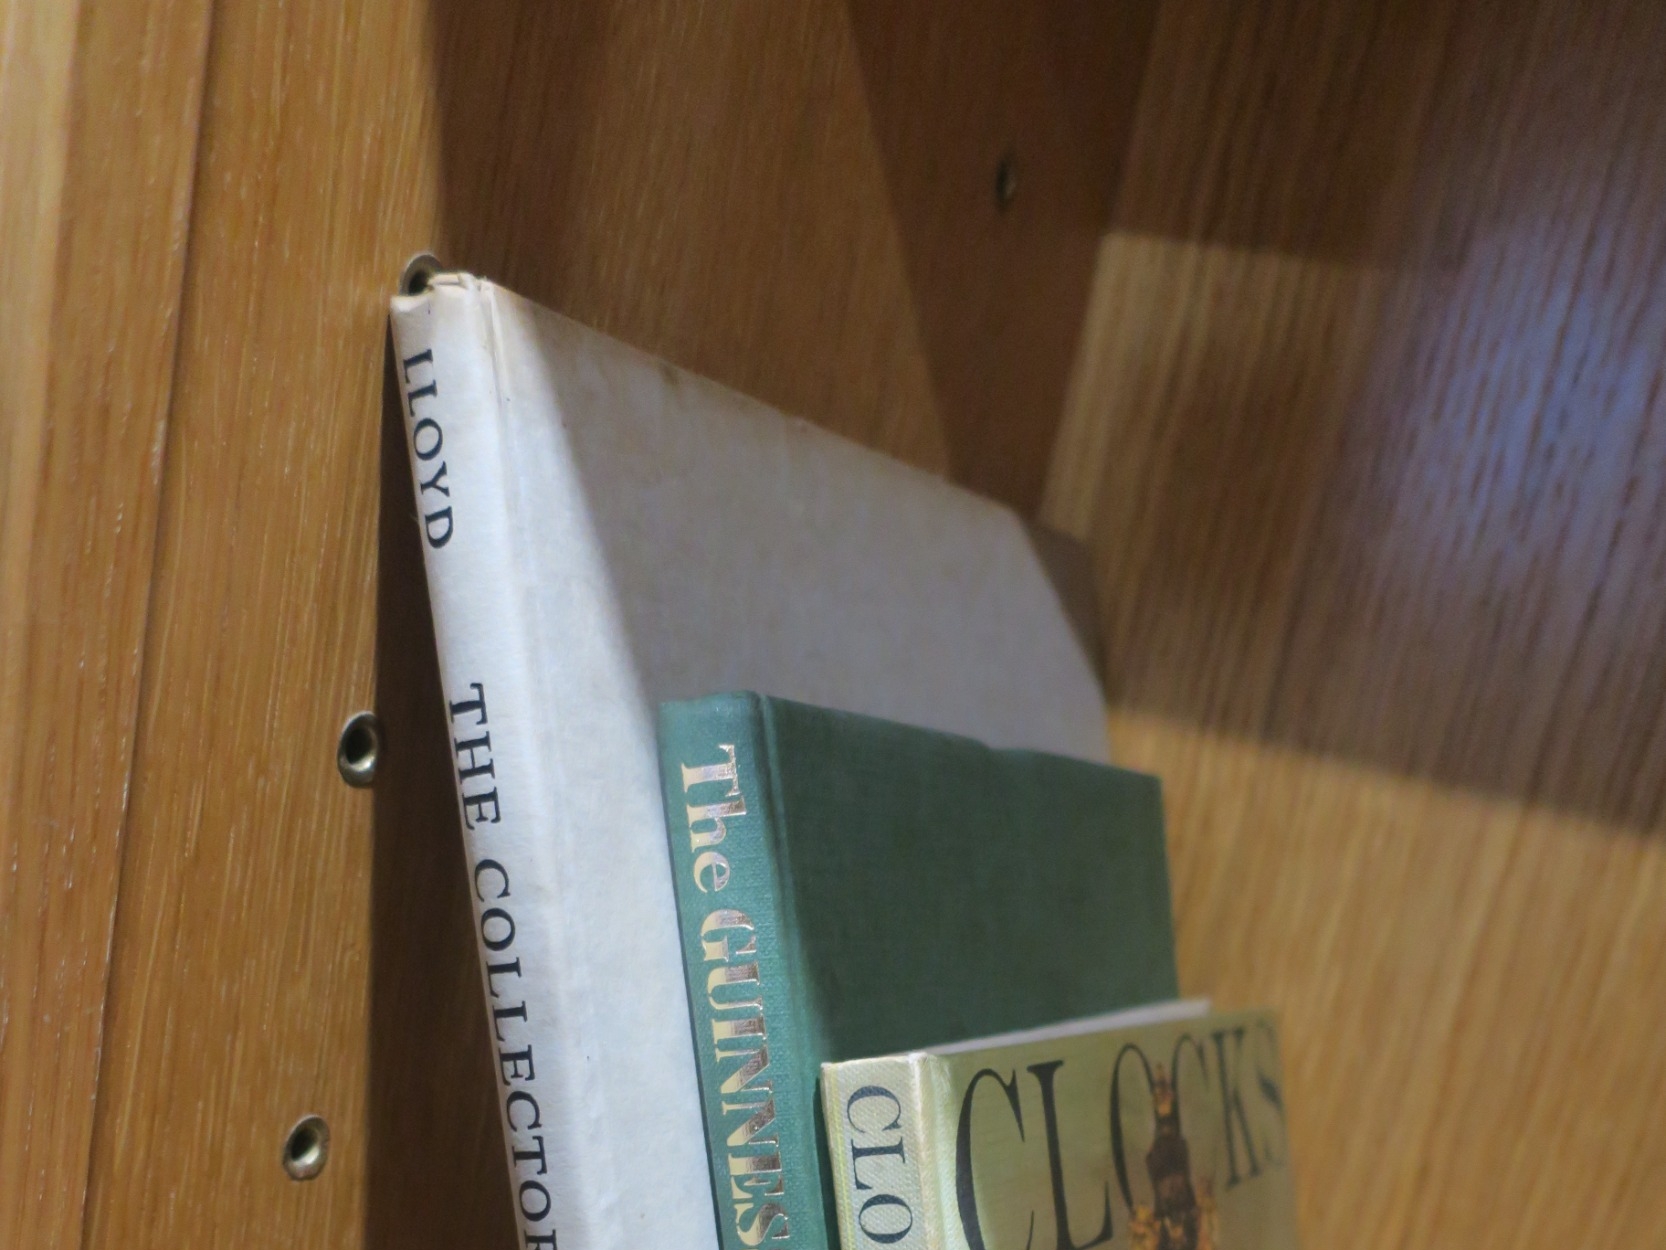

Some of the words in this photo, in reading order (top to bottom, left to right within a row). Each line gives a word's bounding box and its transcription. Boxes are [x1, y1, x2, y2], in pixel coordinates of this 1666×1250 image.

[403, 347, 454, 551] LLOYD
[445, 682, 502, 832] THE
[681, 743, 748, 894] The
